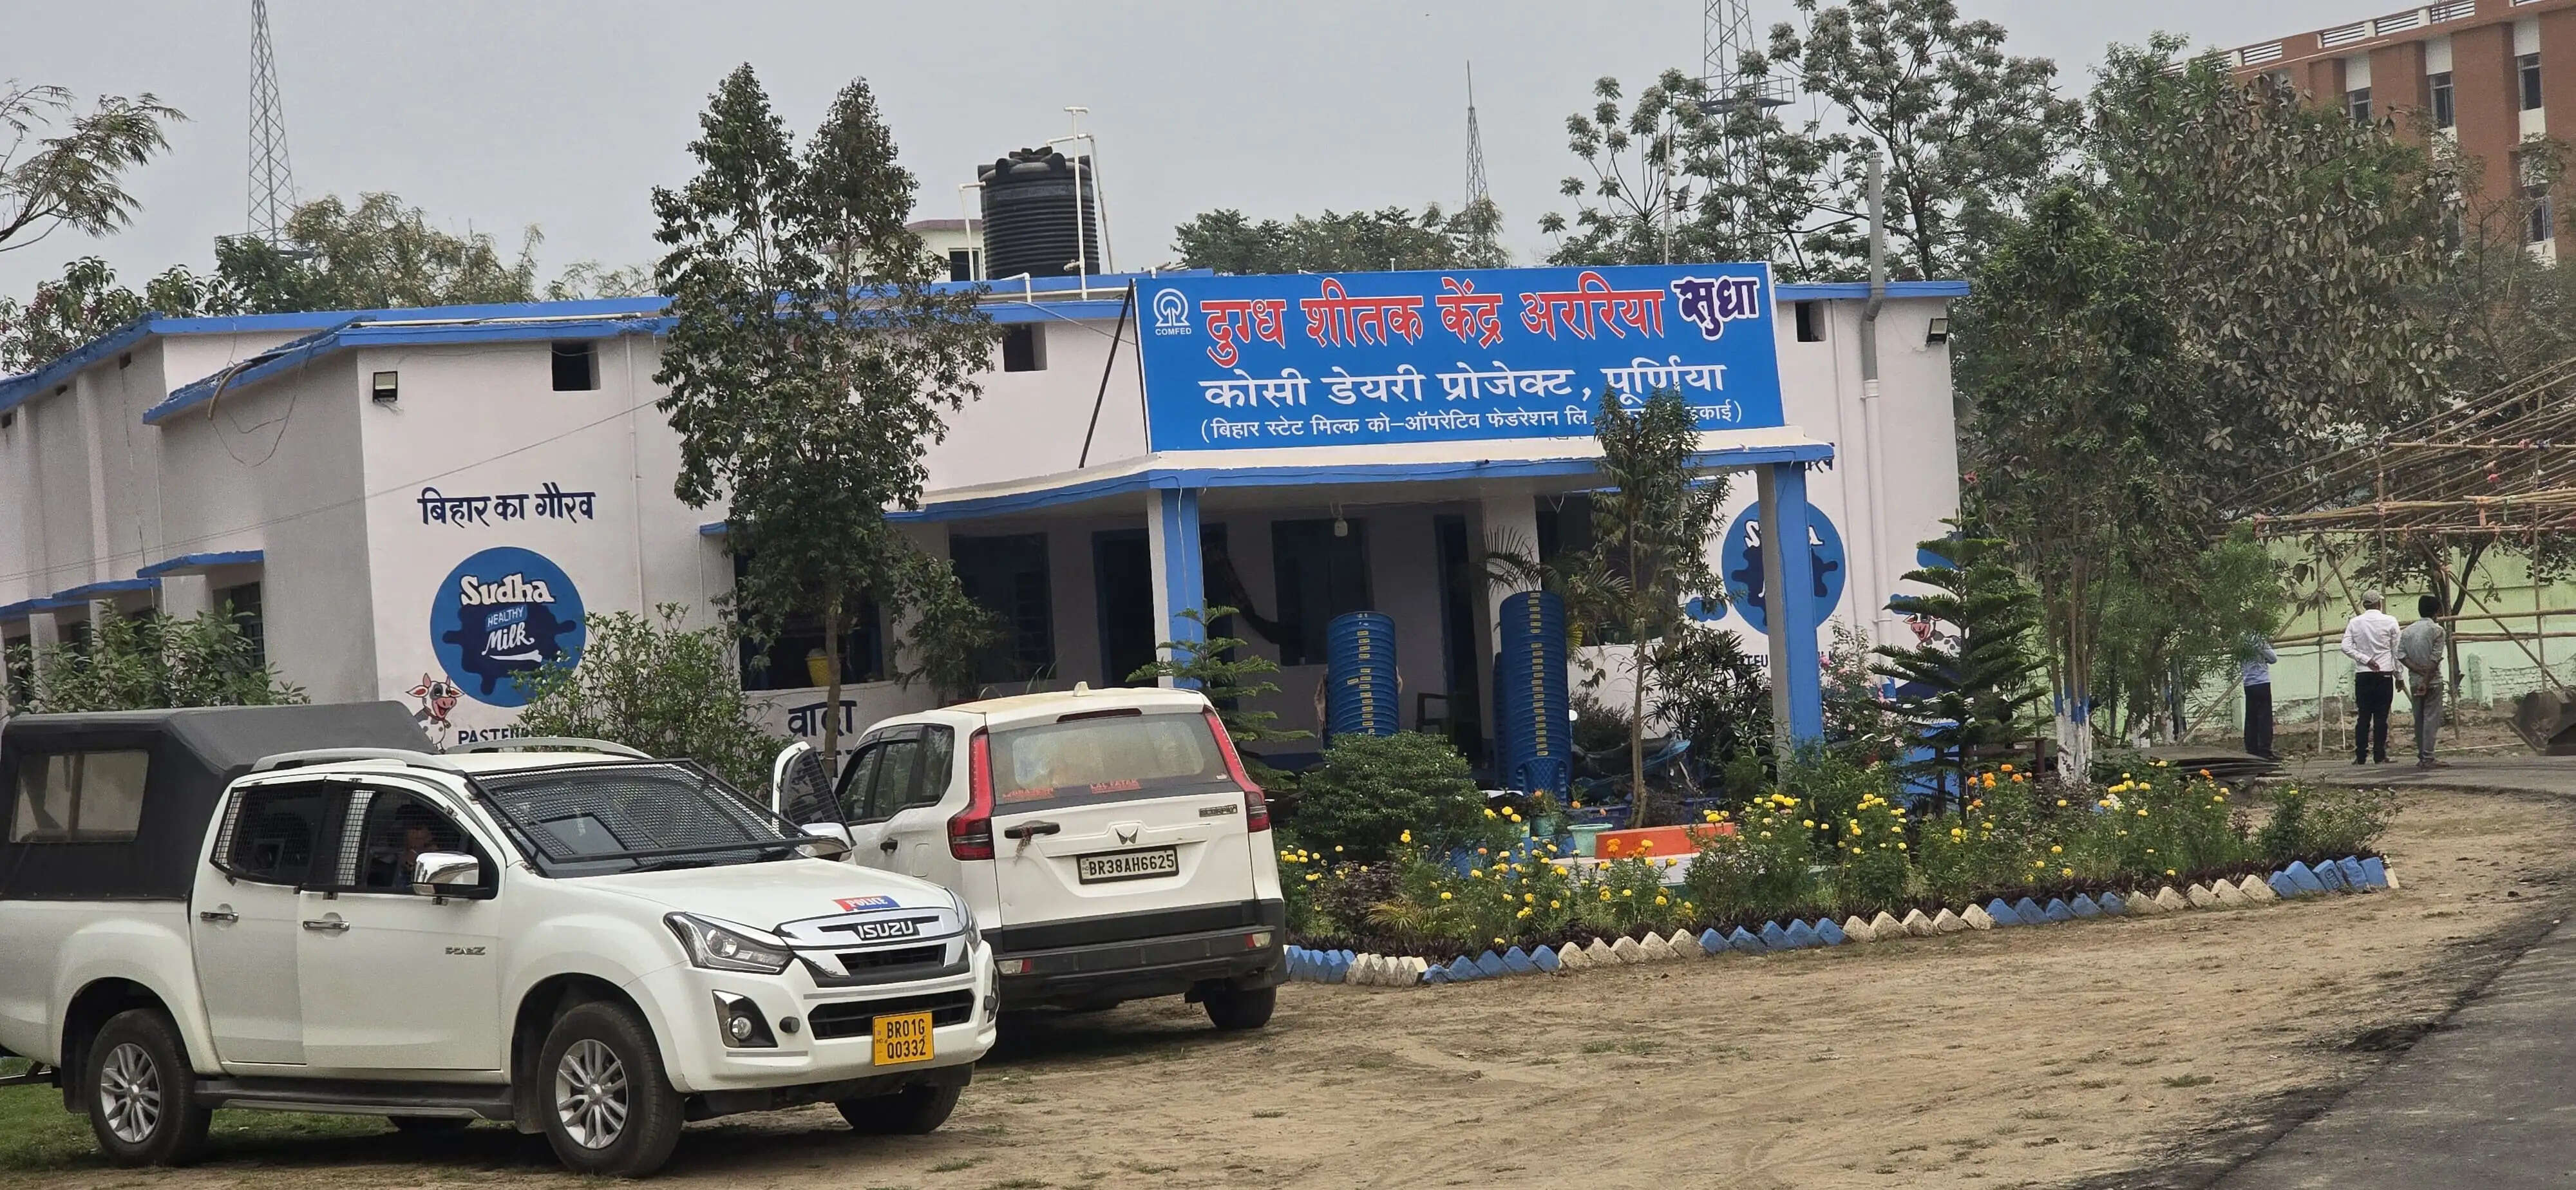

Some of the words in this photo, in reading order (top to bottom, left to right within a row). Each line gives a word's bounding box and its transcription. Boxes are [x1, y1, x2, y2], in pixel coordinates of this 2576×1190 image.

[1200, 299, 1287, 368] दुग्ध
[1300, 278, 1424, 348] शीतक
[1435, 276, 1503, 348] केंद्र
[1519, 271, 1665, 341] अररिया
[1671, 276, 1759, 341] सुधा
[1198, 367, 1311, 408] कोसी
[1320, 364, 1427, 404] डेयरी
[1600, 355, 1728, 404] पूर्णिया
[1201, 417, 1259, 442] (बिहार
[1265, 415, 1304, 437] स्टेट
[1310, 414, 1359, 435] मिल्क
[1486, 407, 1558, 428] फेडरेशन
[417, 487, 491, 528] बिहार
[494, 494, 529, 521] का
[535, 482, 596, 524] गौरव
[460, 572, 556, 607] Sudha
[488, 607, 524, 627] HEALTHY
[482, 622, 535, 656] Milk
[1088, 854, 1175, 876] BR38AH6625
[845, 896, 888, 907] POLICE
[857, 921, 914, 939] ISUZU
[887, 1018, 925, 1039] BR01G
[887, 1038, 926, 1059] Q0332
